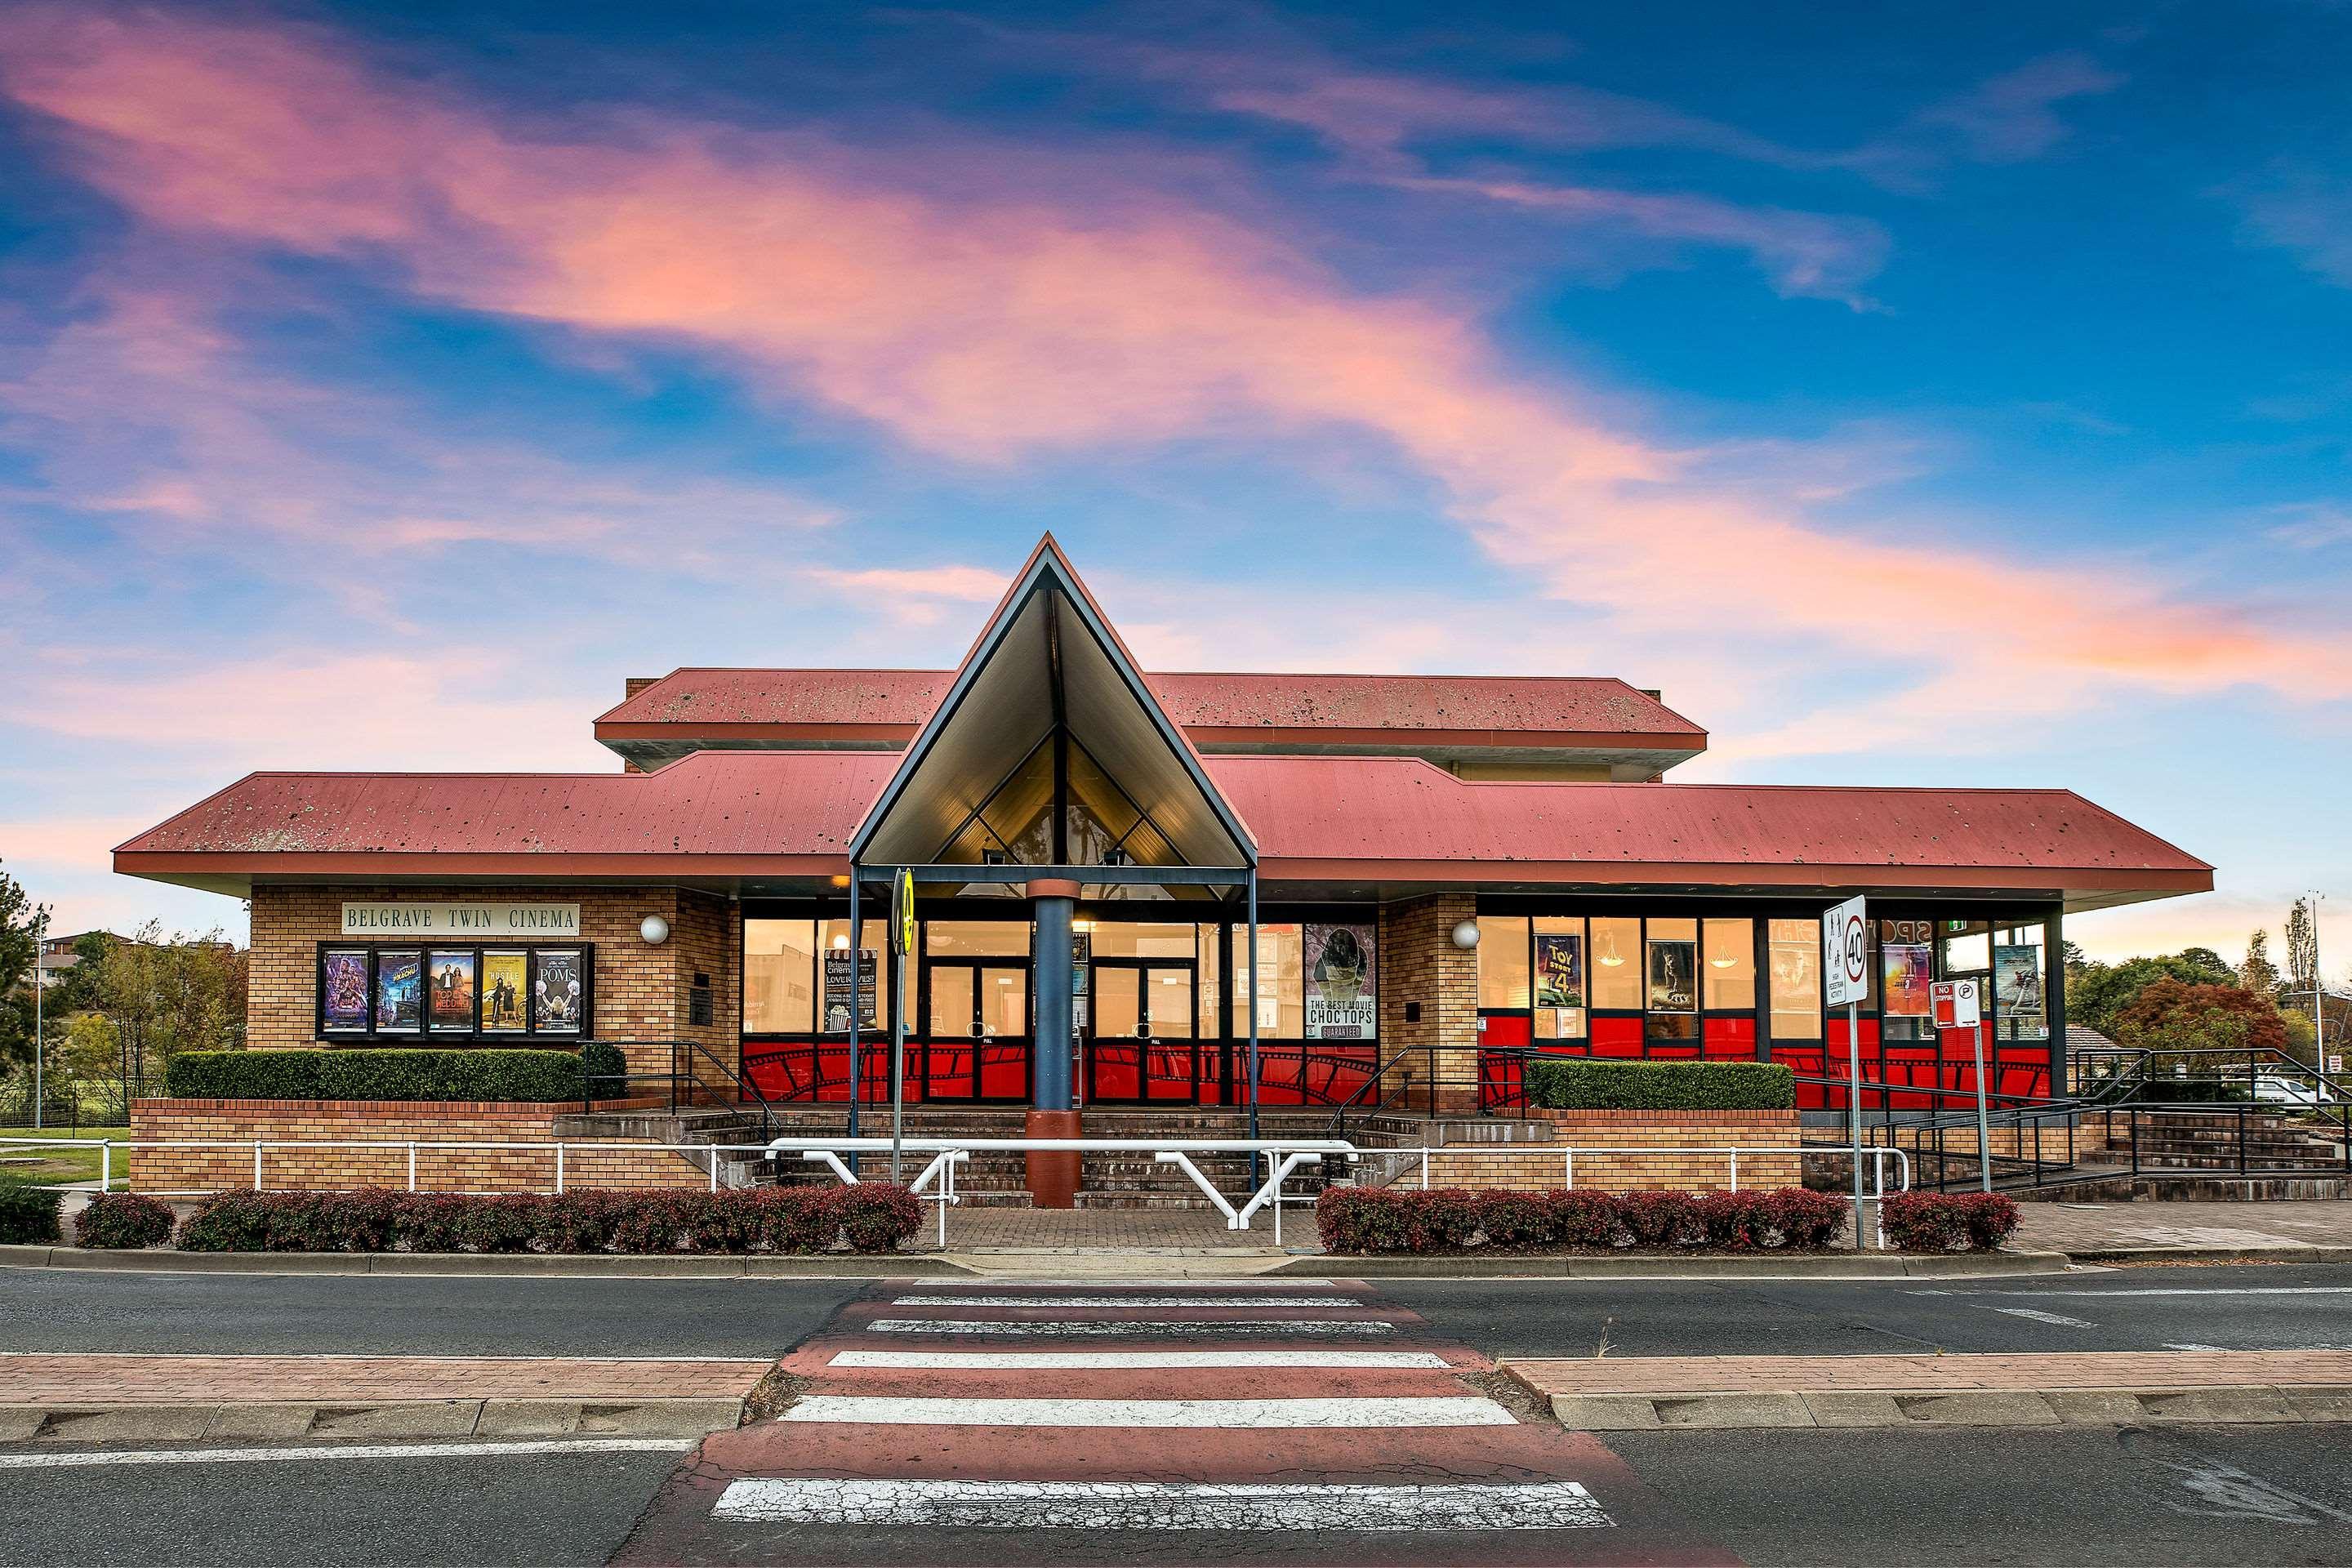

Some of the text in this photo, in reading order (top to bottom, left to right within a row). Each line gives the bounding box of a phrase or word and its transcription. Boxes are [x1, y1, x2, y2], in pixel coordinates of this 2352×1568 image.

[348, 909, 574, 928] BELGRAVE TWIN CINEMA
[1548, 944, 1573, 964] TOY
[1847, 931, 1863, 965] 40
[1549, 961, 1571, 973] STORY
[489, 972, 519, 980] HUSTLE
[540, 968, 577, 982] POMS
[1555, 973, 1569, 993] 4
[435, 990, 452, 999] TOP
[1939, 986, 1949, 995] NO
[1311, 1000, 1372, 1010] THE BEST MOVIE
[1311, 1009, 1372, 1024] CHOC TOPS
[1323, 1027, 1360, 1037] GUARANTEED
